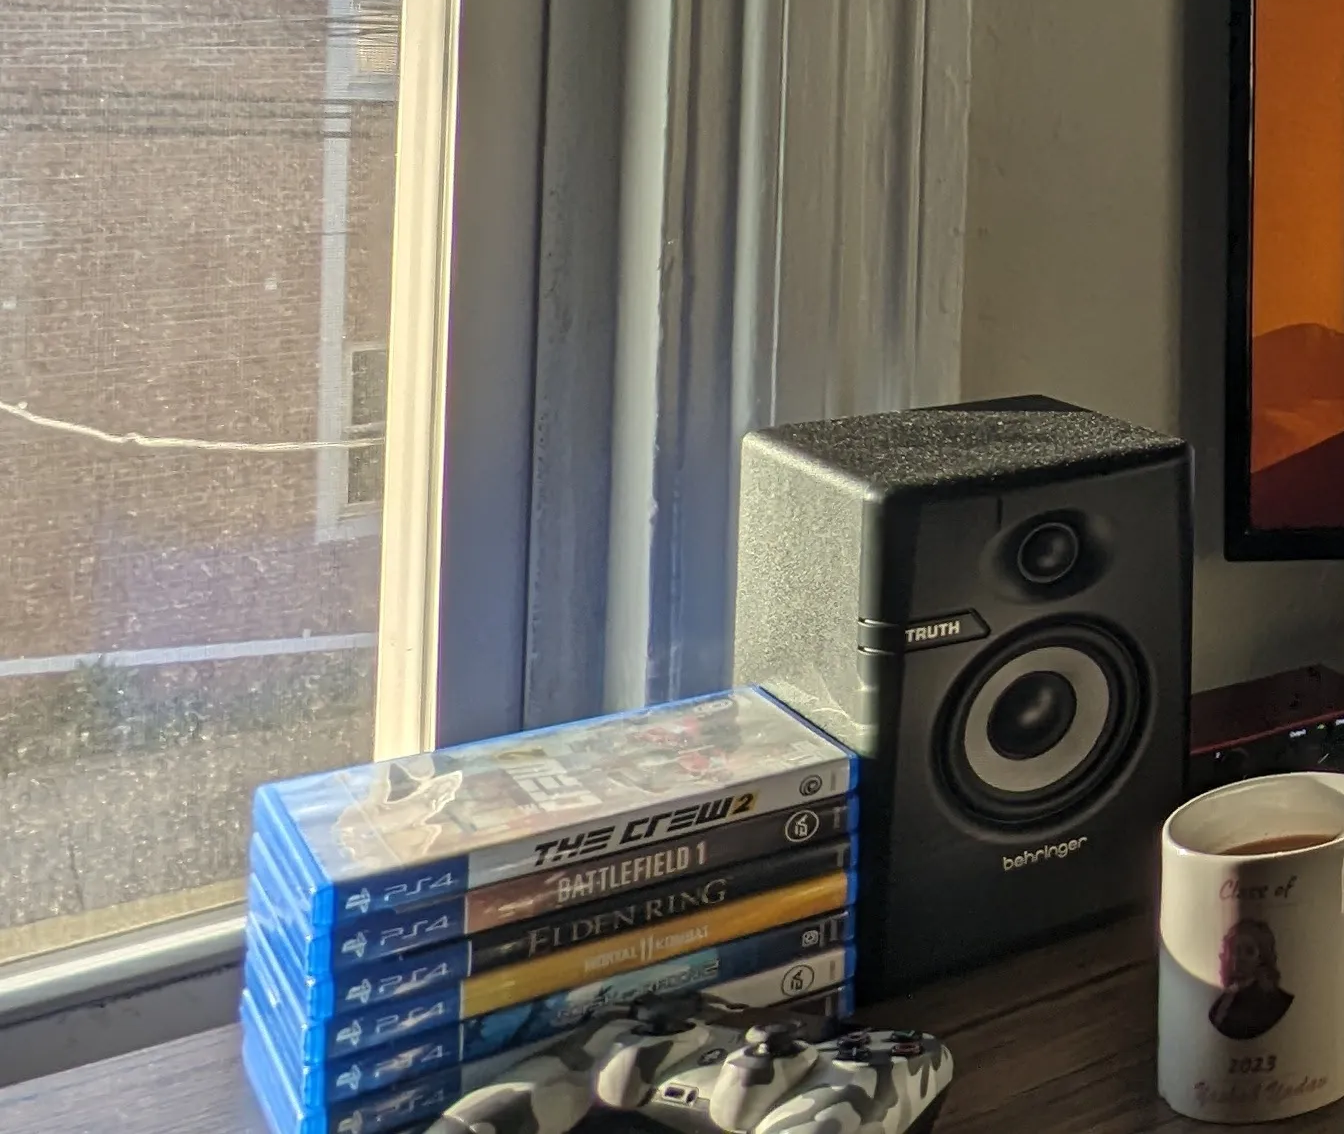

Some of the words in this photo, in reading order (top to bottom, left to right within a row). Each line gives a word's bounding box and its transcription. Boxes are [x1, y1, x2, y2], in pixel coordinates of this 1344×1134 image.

[905, 620, 960, 642] TRUTH
[619, 795, 735, 845] CREW
[733, 793, 754, 814] 2
[1003, 836, 1088, 871] behringer
[384, 872, 453, 901] PS4
[557, 845, 690, 904] BATTLEFIELD
[695, 841, 706, 865] 1
[1219, 879, 1268, 901] Class
[1274, 876, 1298, 899] of
[380, 915, 450, 946] PS4
[527, 904, 636, 957] ELDEN
[646, 878, 727, 920] RING
[584, 948, 639, 972] MORTAL
[656, 925, 709, 950] KOMBAT
[379, 962, 450, 993] PS4
[375, 1001, 444, 1034] PS4
[1229, 1055, 1277, 1074] 2023
